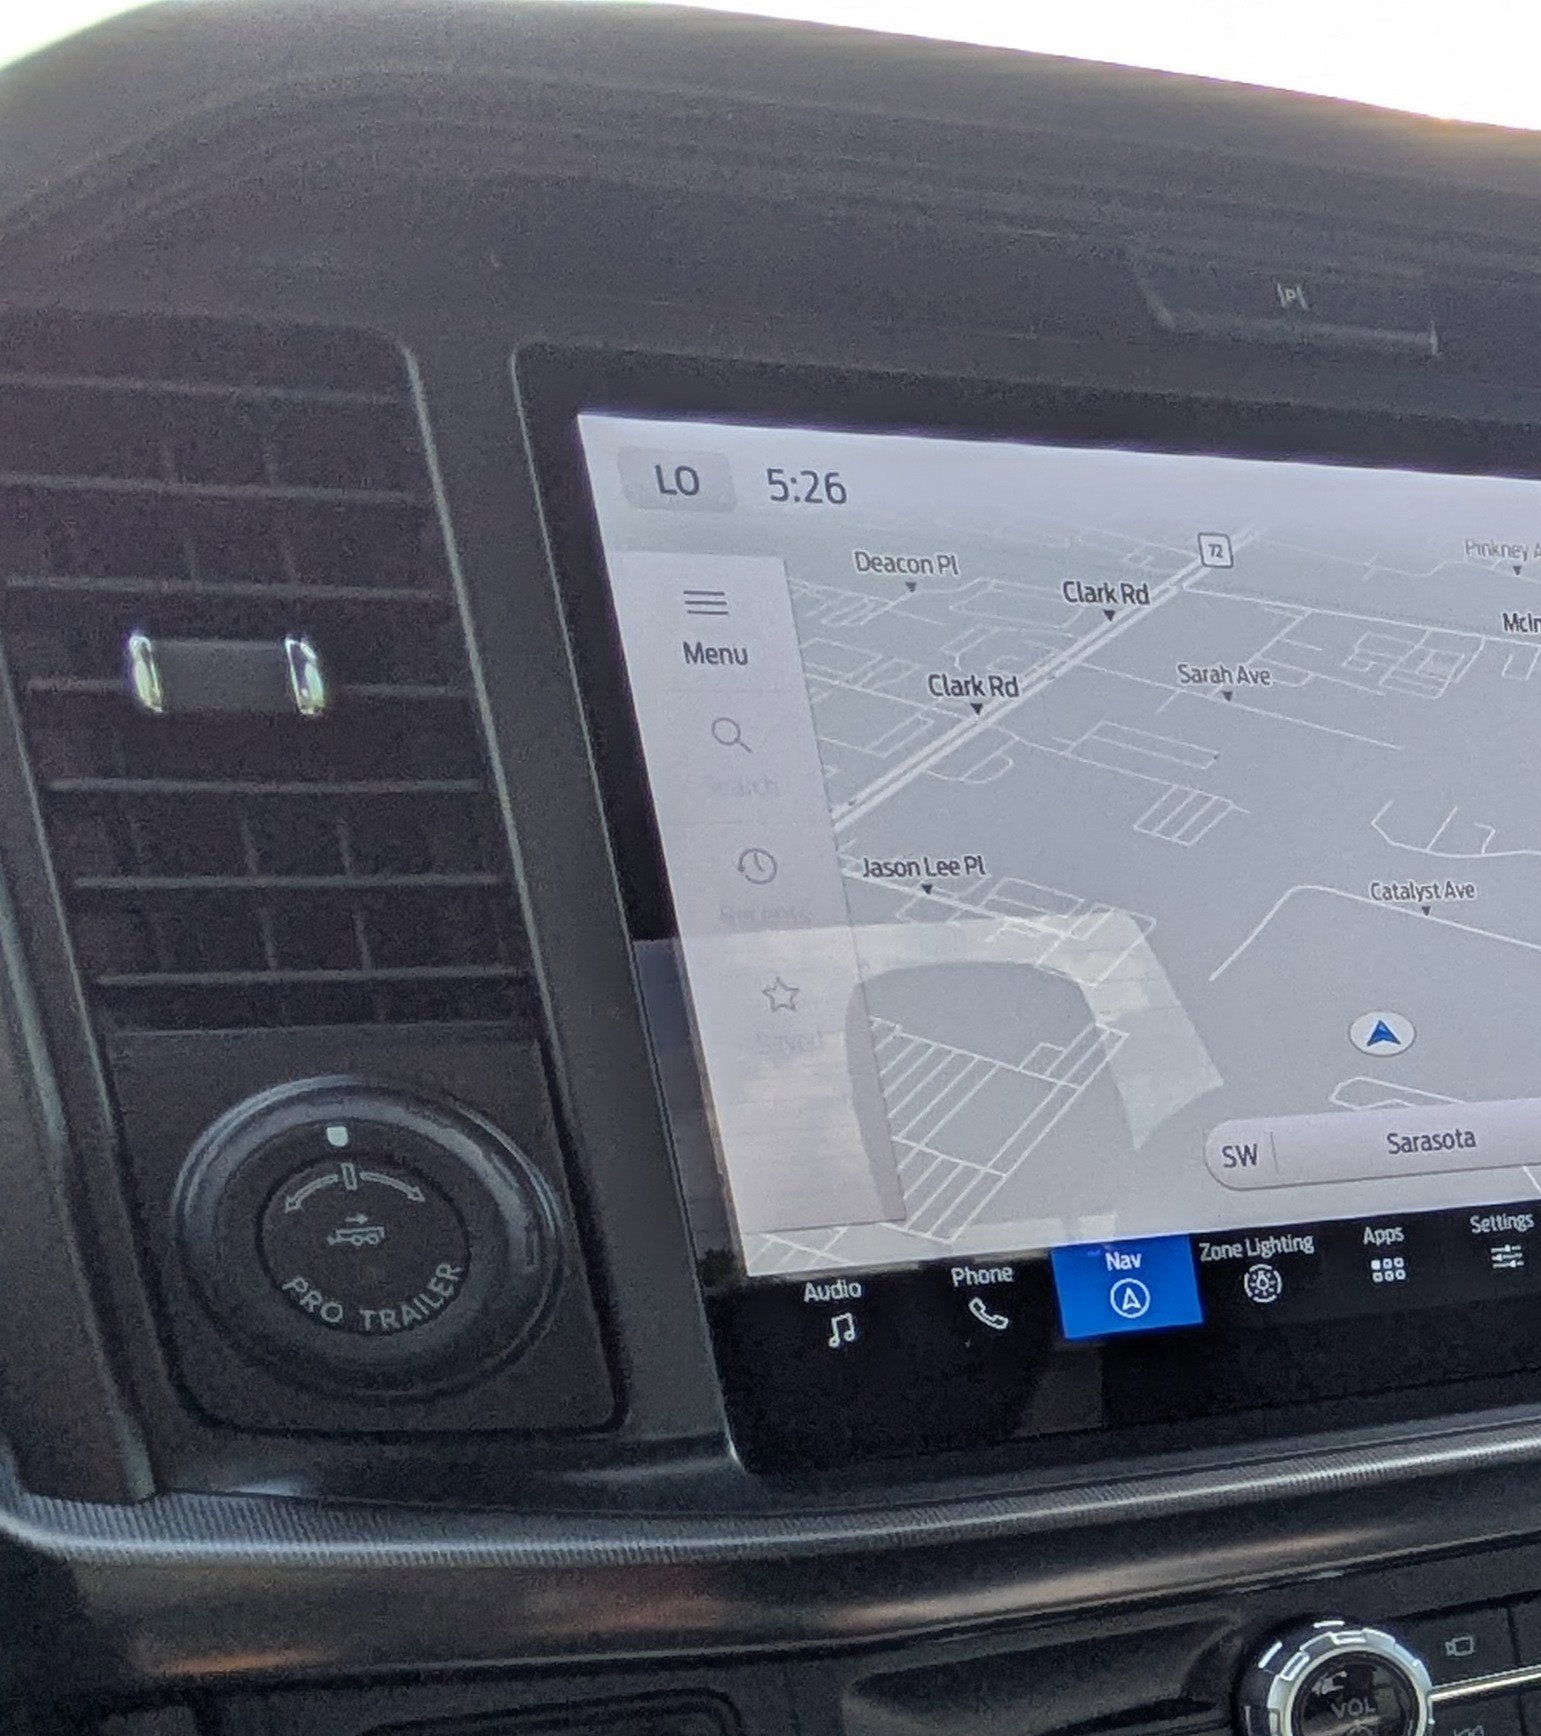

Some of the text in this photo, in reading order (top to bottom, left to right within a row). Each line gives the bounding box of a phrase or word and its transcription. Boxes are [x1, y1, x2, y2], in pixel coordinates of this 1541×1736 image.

[653, 462, 701, 498] LO
[766, 467, 848, 506] 5:26
[854, 550, 960, 576] Deacon Pl
[1208, 543, 1223, 560] 72
[1062, 580, 1150, 607] Clark Rd
[682, 641, 750, 667] Menu
[927, 673, 1019, 700] Clark Rd
[1177, 663, 1270, 687] Sarah Ave
[862, 855, 986, 880] Jason Lee Pl
[1369, 880, 1475, 904] Catalyst Ave
[1386, 1126, 1477, 1156] Sarasota
[1221, 1144, 1259, 1168] SW
[1362, 1224, 1405, 1248] Apps
[1469, 1211, 1535, 1236] Settings
[1198, 1233, 1315, 1262] Zone Lighting
[1105, 1251, 1142, 1271] Nav
[950, 1263, 1014, 1288] Phone
[282, 1261, 463, 1332] PRO TRAILER
[803, 1279, 863, 1303] Audio
[1330, 1697, 1376, 1719] VOL
